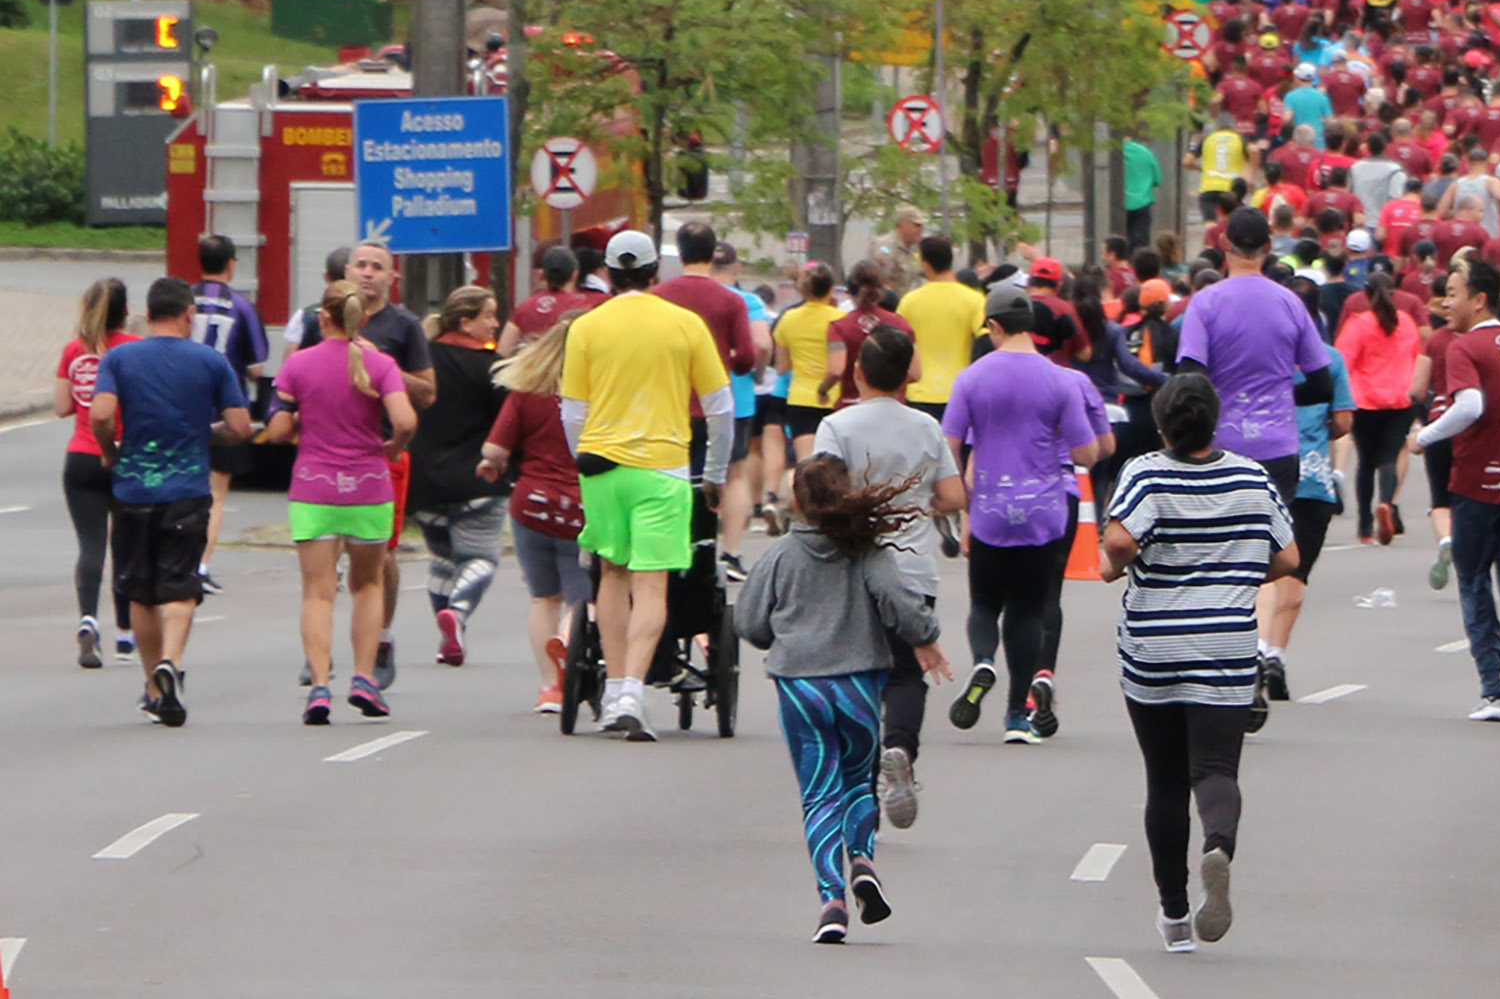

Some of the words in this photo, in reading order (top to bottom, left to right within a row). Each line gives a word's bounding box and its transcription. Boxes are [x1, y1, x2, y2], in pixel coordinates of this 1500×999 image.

[401, 111, 465, 132] Acesso
[363, 138, 503, 162] Estacionamento
[394, 167, 474, 193] Shopping
[391, 195, 477, 217] Palladium
